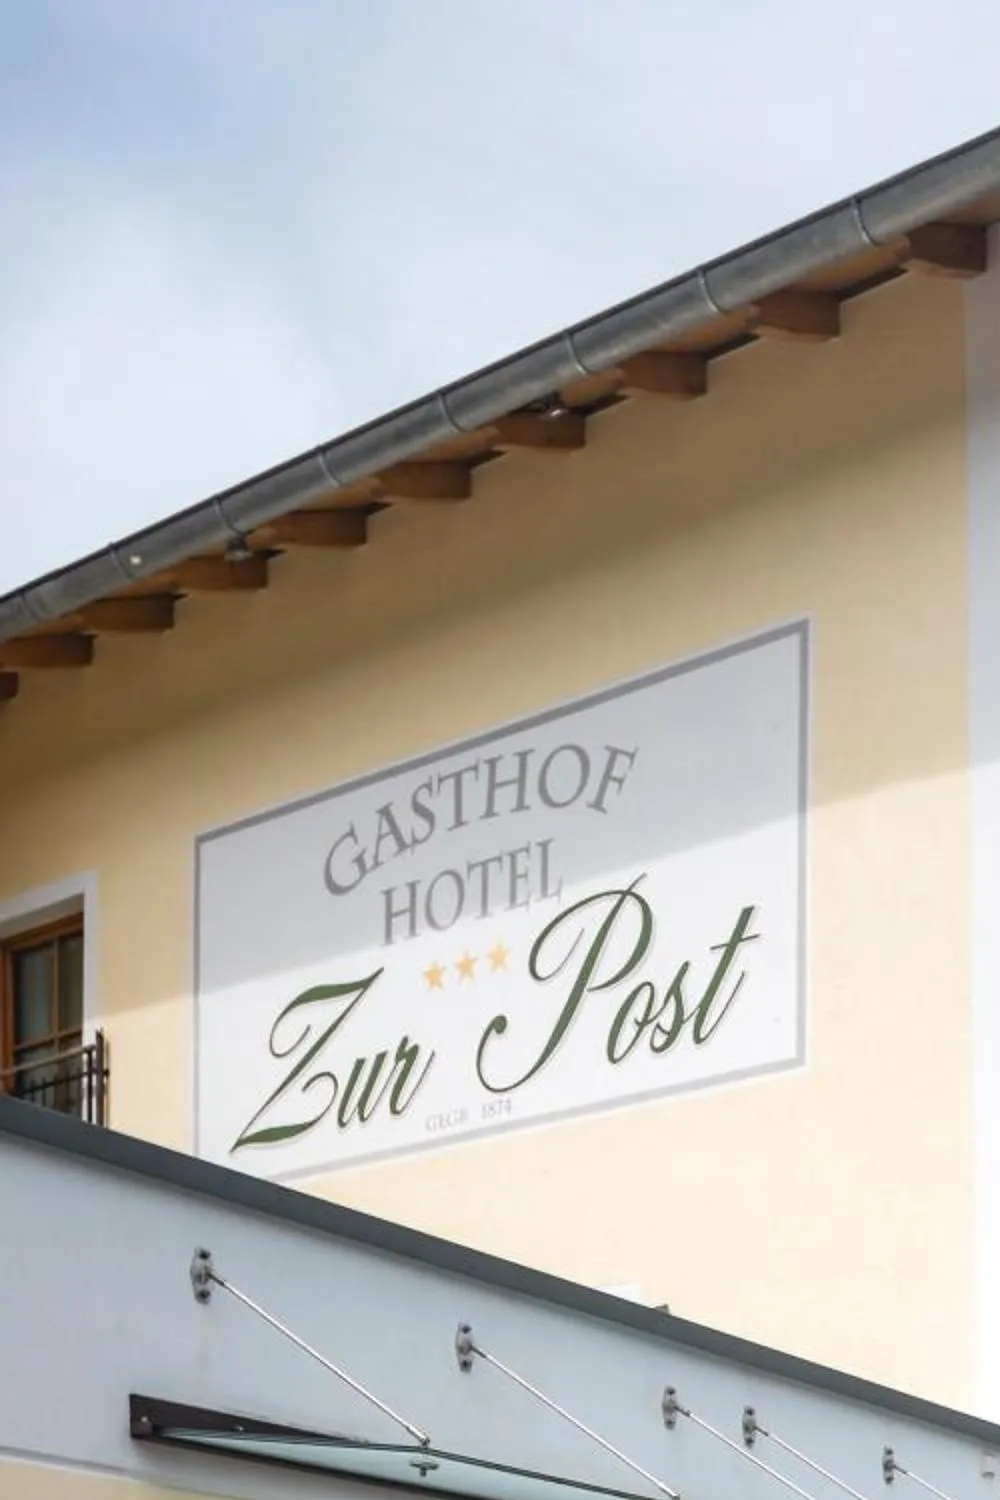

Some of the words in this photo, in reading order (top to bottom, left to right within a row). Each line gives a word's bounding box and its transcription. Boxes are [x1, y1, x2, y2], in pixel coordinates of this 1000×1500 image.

[322, 741, 639, 896] GASTHOF
[380, 838, 563, 946] HOTEL
[229, 967, 435, 1152] Zur
[476, 873, 760, 1094] Post
